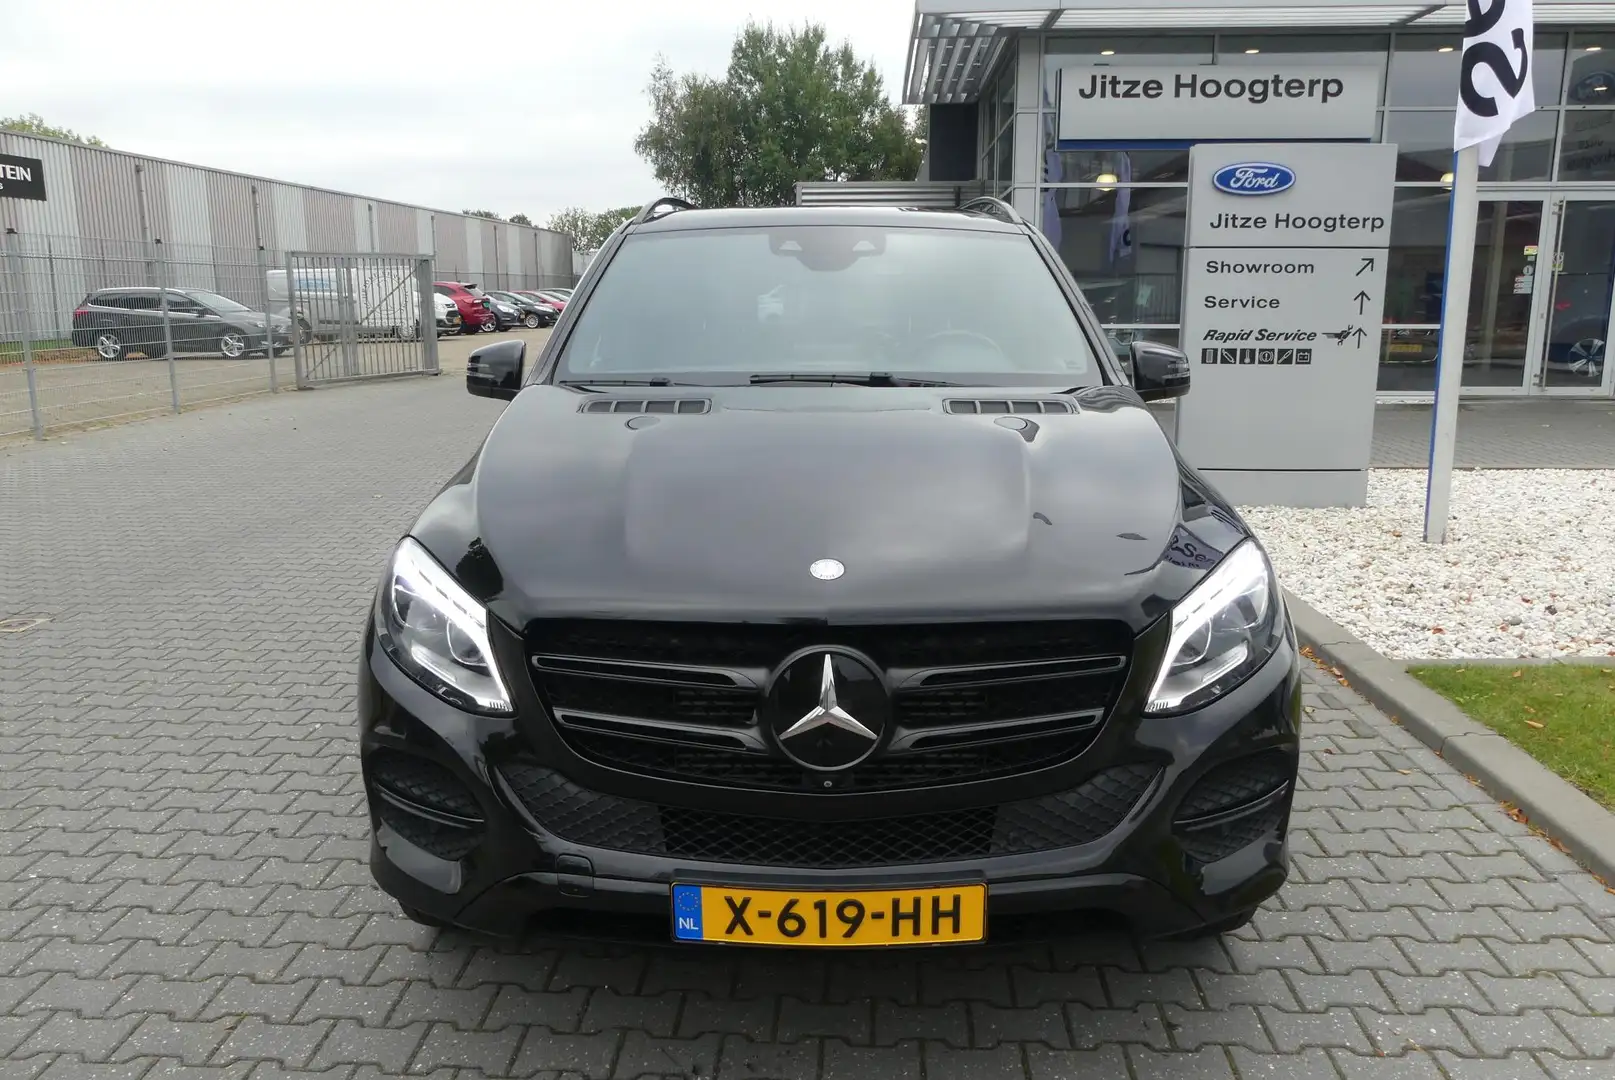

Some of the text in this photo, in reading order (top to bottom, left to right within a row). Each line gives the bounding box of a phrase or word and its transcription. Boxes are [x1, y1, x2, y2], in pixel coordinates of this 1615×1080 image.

[1078, 74, 1344, 104] Jitze Hoogterp
[1229, 167, 1280, 190] Ford
[1209, 213, 1385, 232] Jitze Hoogterp
[1206, 260, 1315, 274] Showroom
[1204, 295, 1280, 309] Service
[1203, 328, 1317, 344] Rapid Service
[679, 916, 699, 931] NL
[724, 894, 961, 938] X-619-HH
